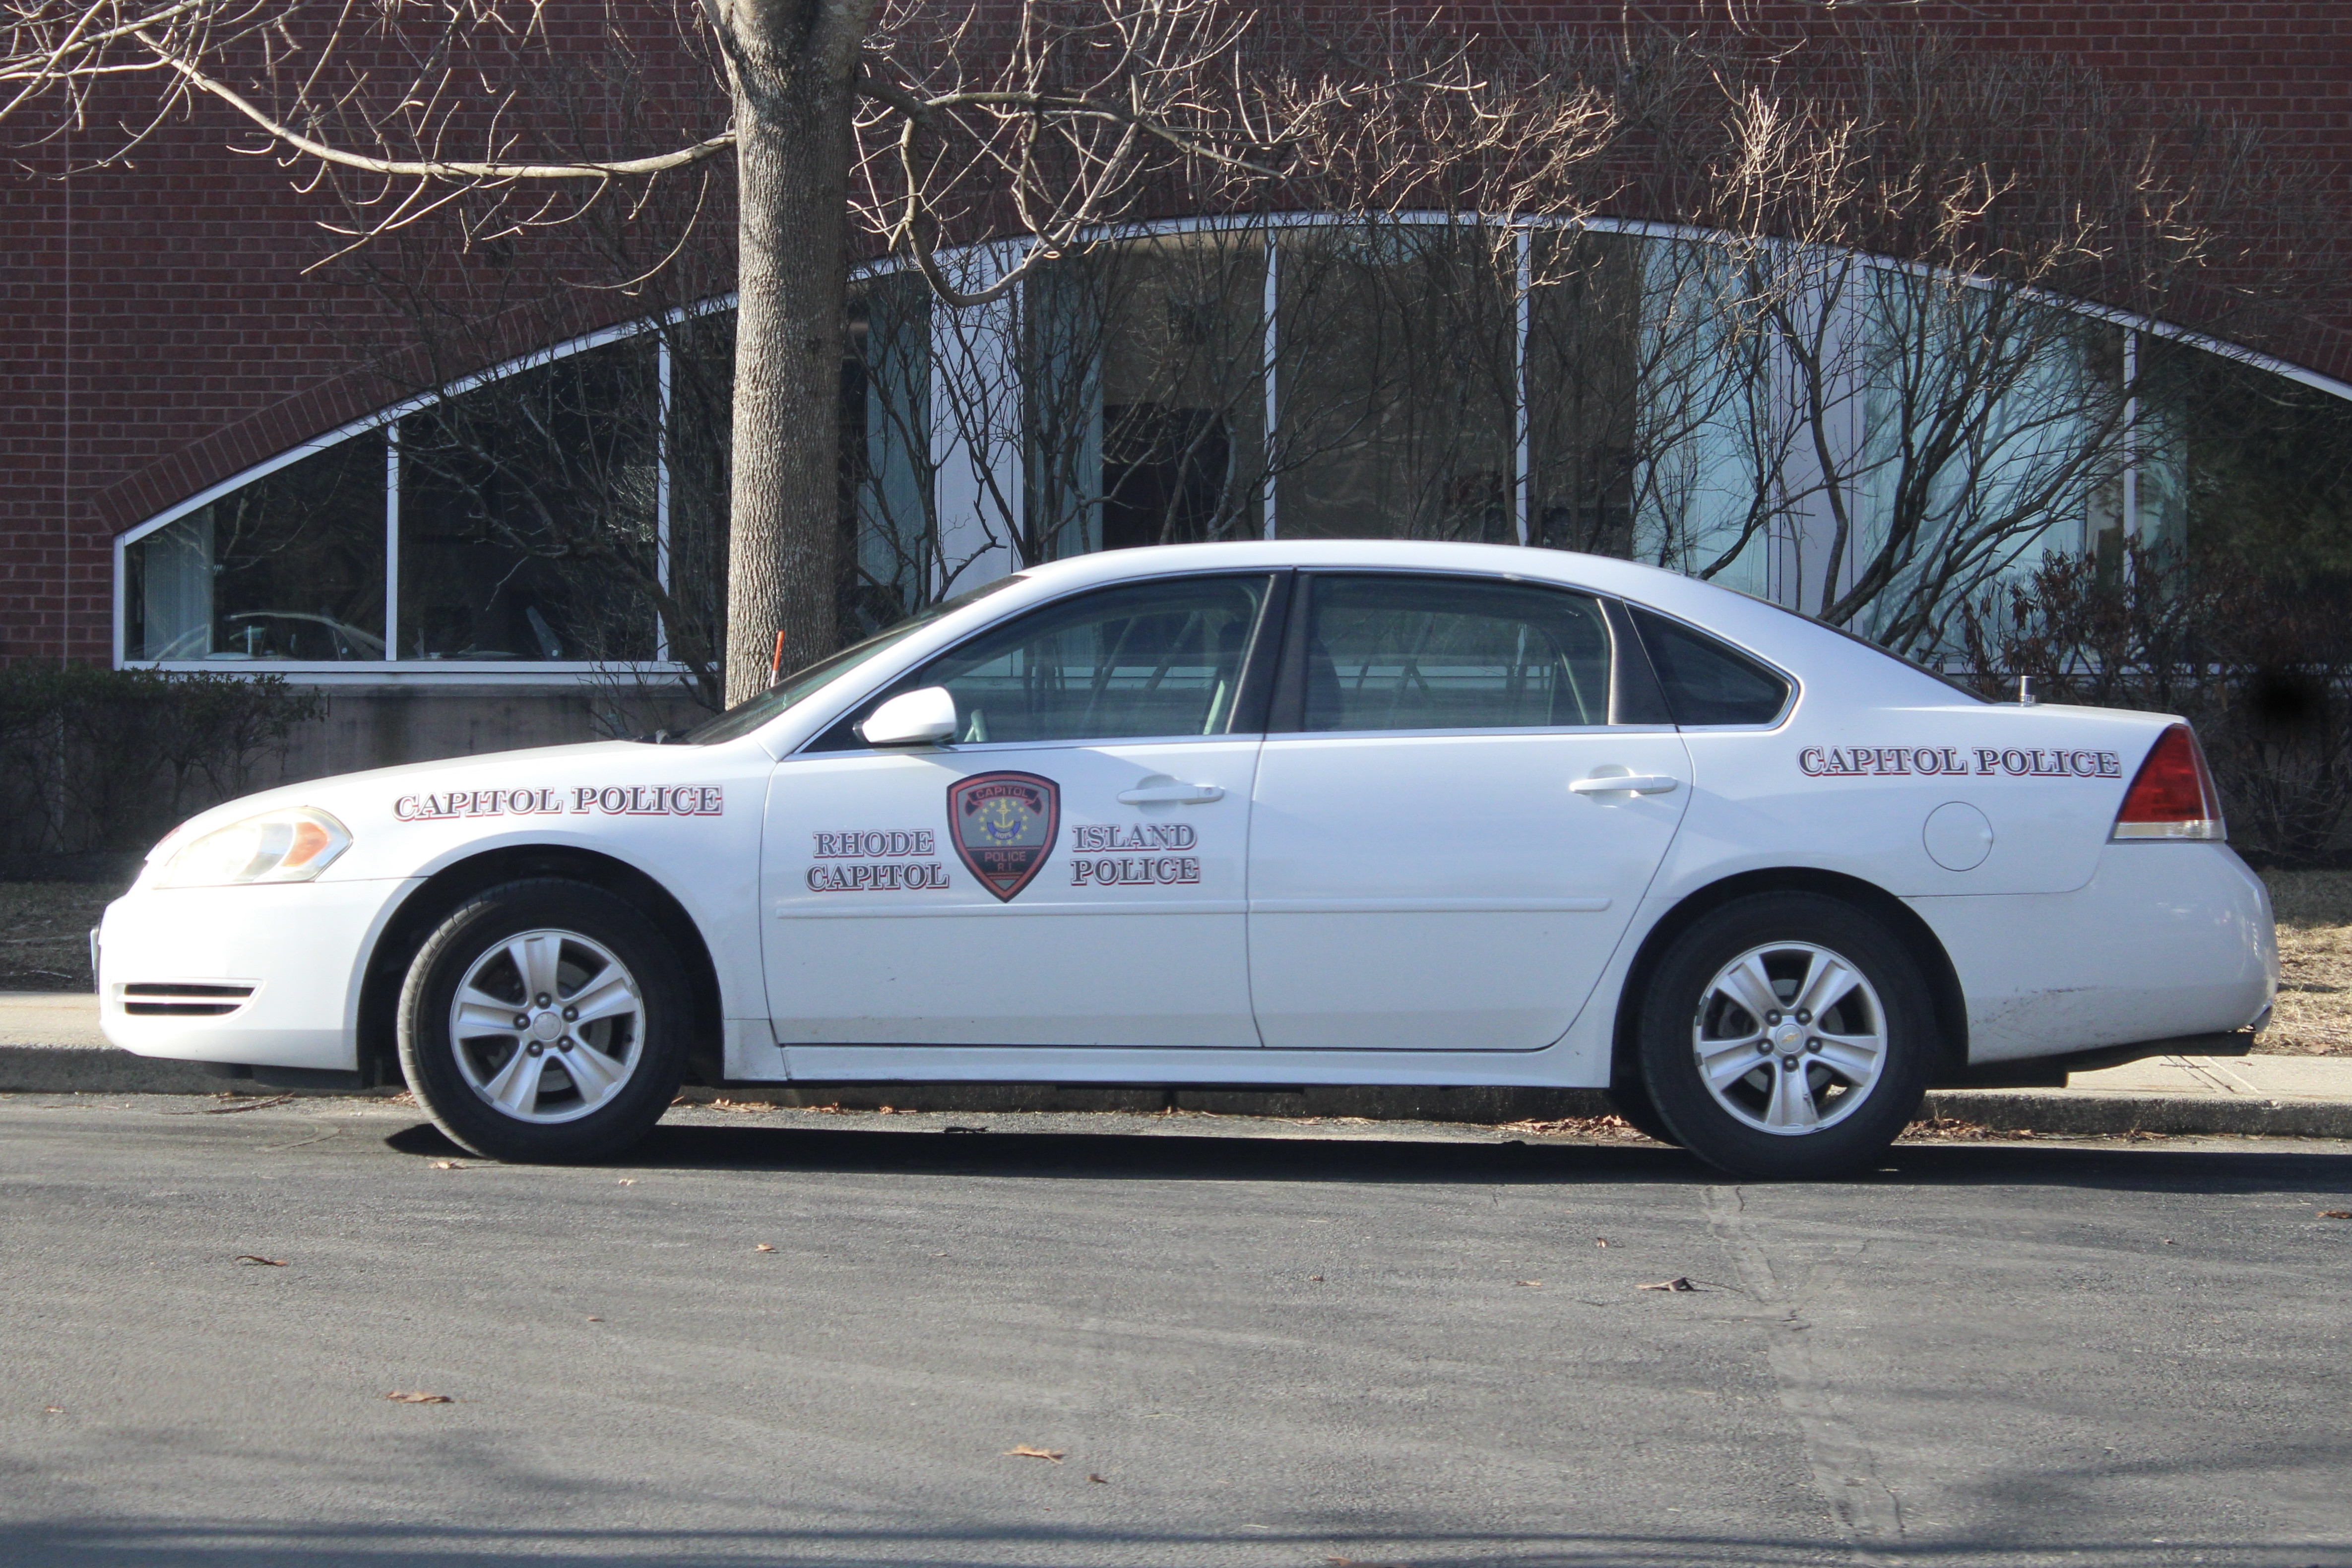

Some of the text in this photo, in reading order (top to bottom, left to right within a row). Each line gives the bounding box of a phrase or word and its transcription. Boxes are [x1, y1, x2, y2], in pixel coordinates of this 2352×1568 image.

[1797, 746, 2122, 778] CAPITOL POLICE
[391, 784, 723, 822] CAPITOL POLICE
[976, 786, 1027, 798] CAPITOL
[813, 823, 1197, 858] RHODE ISLAND
[985, 851, 1026, 862] POLICE
[805, 856, 1200, 892] CAPITOL POLICE
